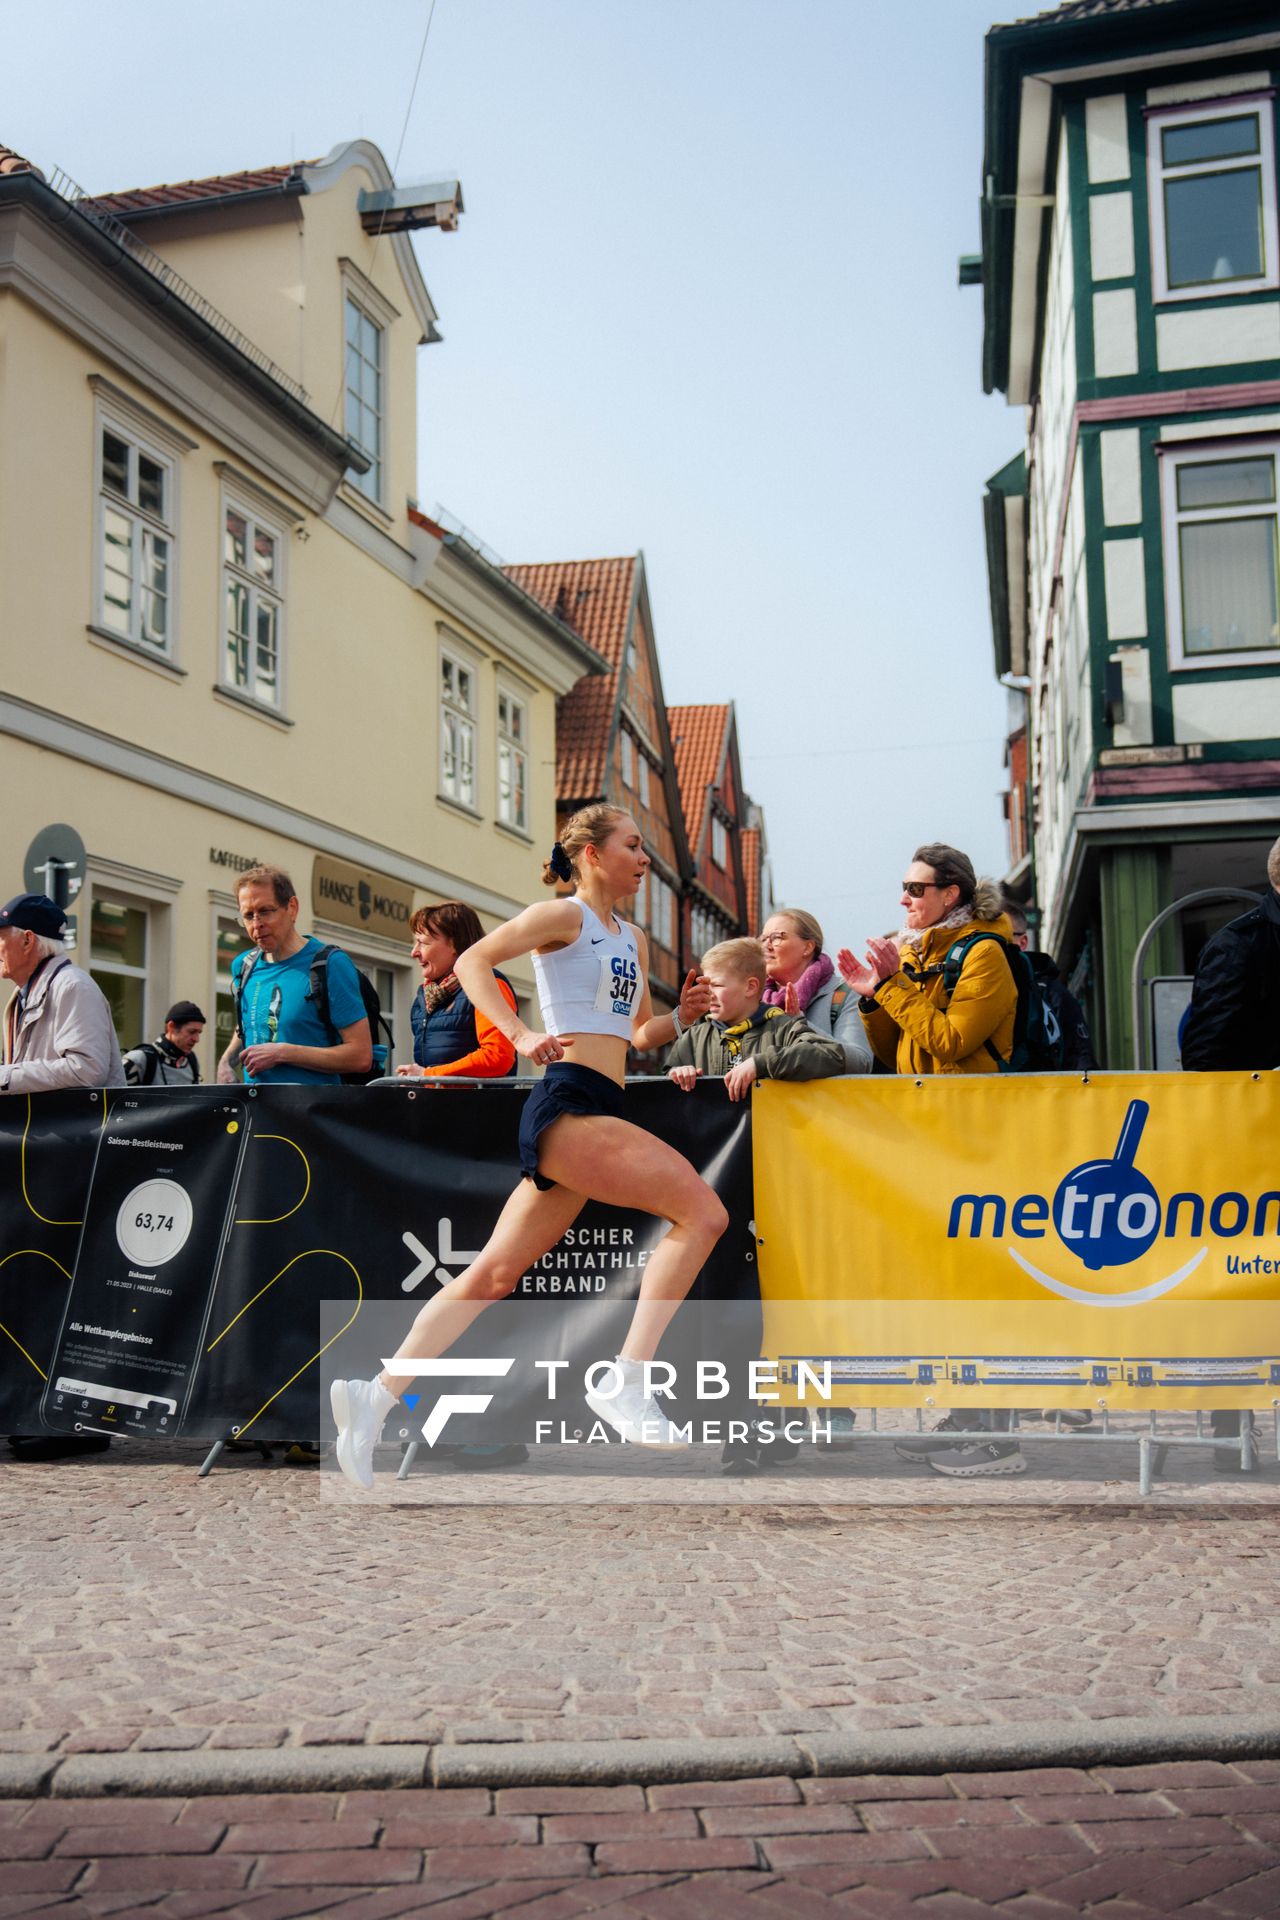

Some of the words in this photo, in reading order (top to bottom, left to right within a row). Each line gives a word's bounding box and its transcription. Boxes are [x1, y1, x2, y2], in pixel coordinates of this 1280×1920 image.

[319, 876, 355, 908] HANSE
[373, 894, 410, 922] MOCCA
[610, 956, 637, 981] GLS
[609, 976, 637, 1003] 347
[107, 1136, 184, 1151] Saison-Bestleistungen
[135, 1212, 174, 1232] 63,74
[555, 1228, 634, 1245] SCHER
[511, 1275, 606, 1293] ERBAND
[69, 1321, 83, 1332] Alle
[83, 1324, 154, 1345] Wettkampfergebnisse
